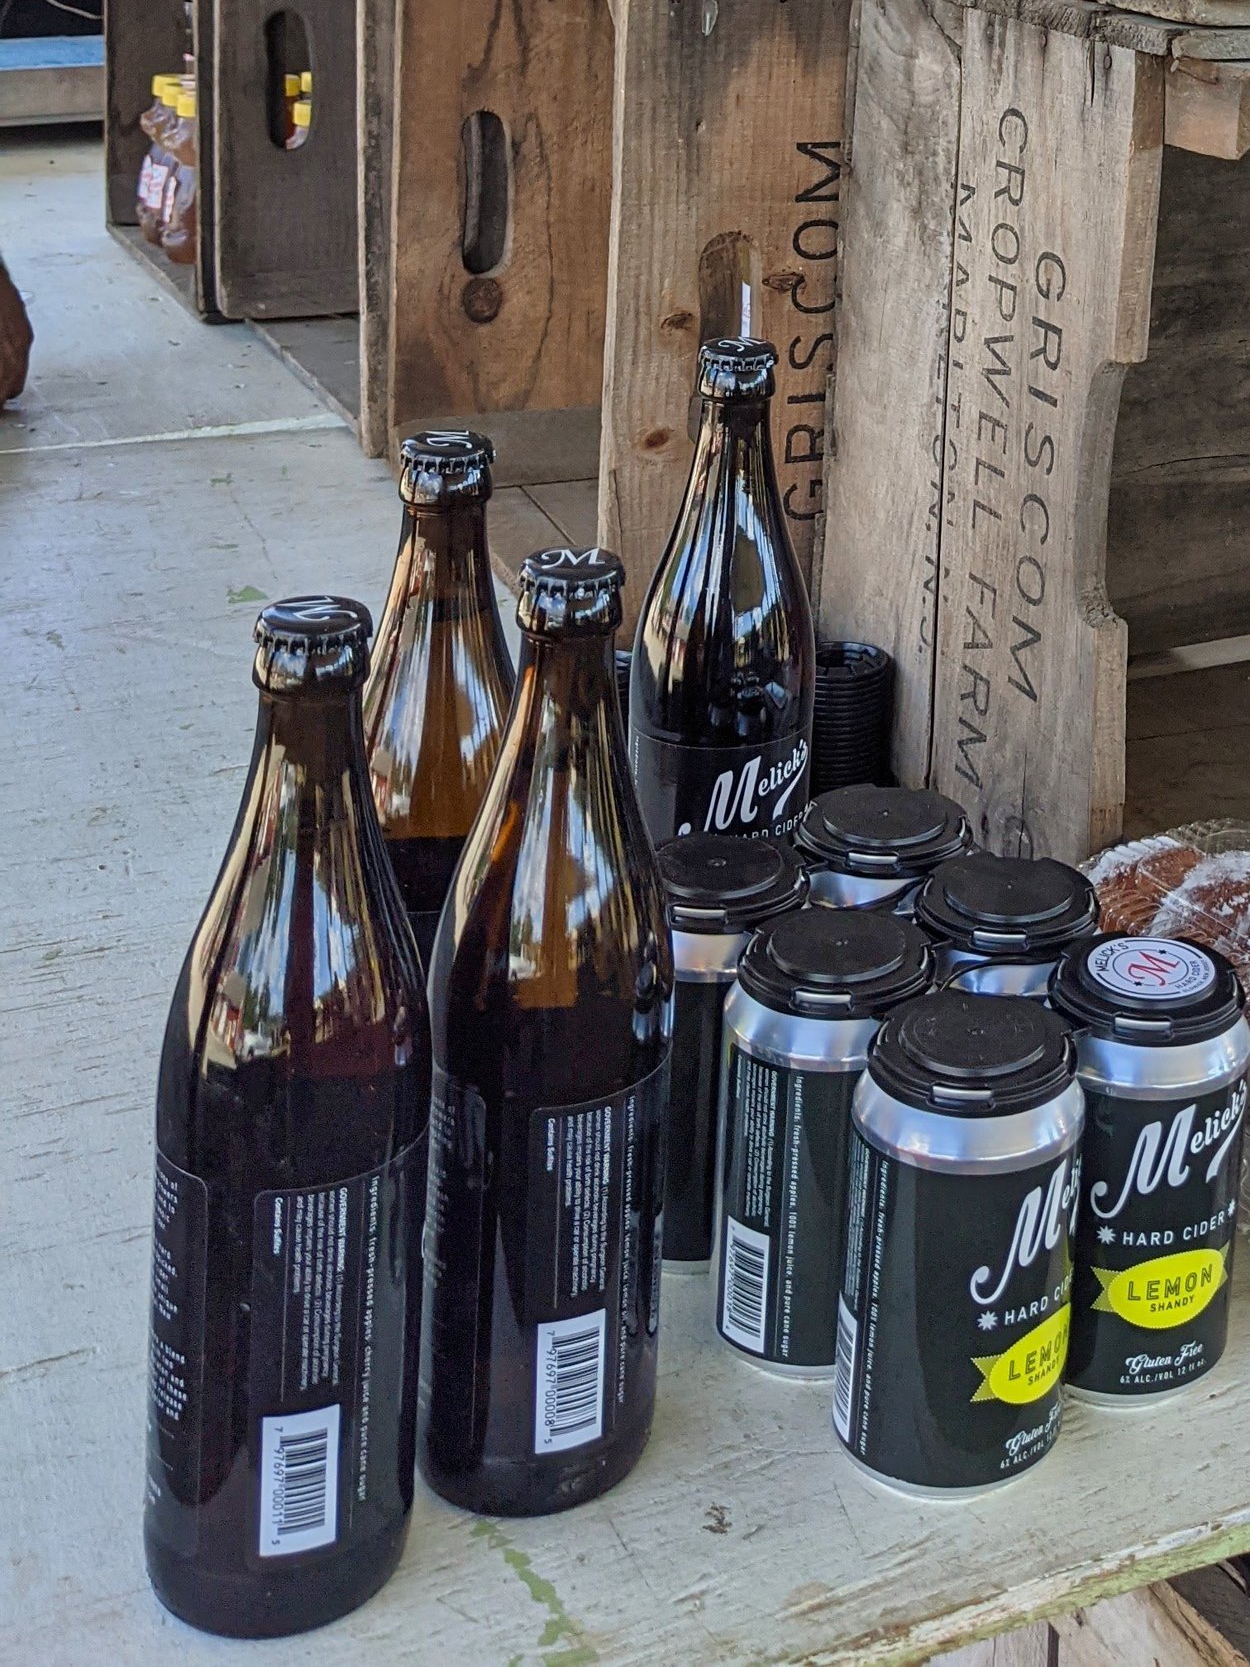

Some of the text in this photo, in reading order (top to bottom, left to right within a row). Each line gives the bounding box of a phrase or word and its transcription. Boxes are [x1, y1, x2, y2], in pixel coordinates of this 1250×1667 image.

[783, 140, 842, 523] GRISCOM
[955, 107, 1029, 790] CROPWELL FARM
[1008, 251, 1066, 703] GRISCOM
[541, 547, 605, 570] M
[1095, 942, 1129, 972] MELICK'S
[1128, 950, 1180, 987] M
[790, 1124, 802, 1179] fresh-pressed
[1090, 1078, 1247, 1219] Melick's
[272, 1197, 283, 1255] Contains Sulfites
[336, 1187, 349, 1237] GOVERNMENT
[789, 1211, 797, 1229] 100%
[1123, 1211, 1225, 1246] HARD CIDER
[787, 1230, 796, 1254] lemon
[873, 1212, 885, 1269] fresh-pressed
[363, 1237, 377, 1307] fresh-pressed
[785, 1280, 793, 1294] and
[1127, 1263, 1213, 1301] LEMON
[782, 1296, 792, 1313] pure
[1005, 1297, 1048, 1326] HARD
[1150, 1295, 1195, 1312] SHANDY
[782, 1315, 790, 1333] cane
[361, 1346, 373, 1378] cherry
[781, 1335, 790, 1357] sugar
[1125, 1341, 1205, 1374] Gluten Free
[545, 1347, 559, 1385] 97697
[864, 1374, 873, 1389] and
[1120, 1375, 1132, 1384] 6%
[1177, 1366, 1187, 1376] 12
[361, 1406, 372, 1424] and
[545, 1389, 557, 1427] 00008
[862, 1391, 871, 1409] pure
[1006, 1423, 1044, 1456] Gluten
[272, 1446, 286, 1485] 97697
[272, 1488, 284, 1526] 00011
